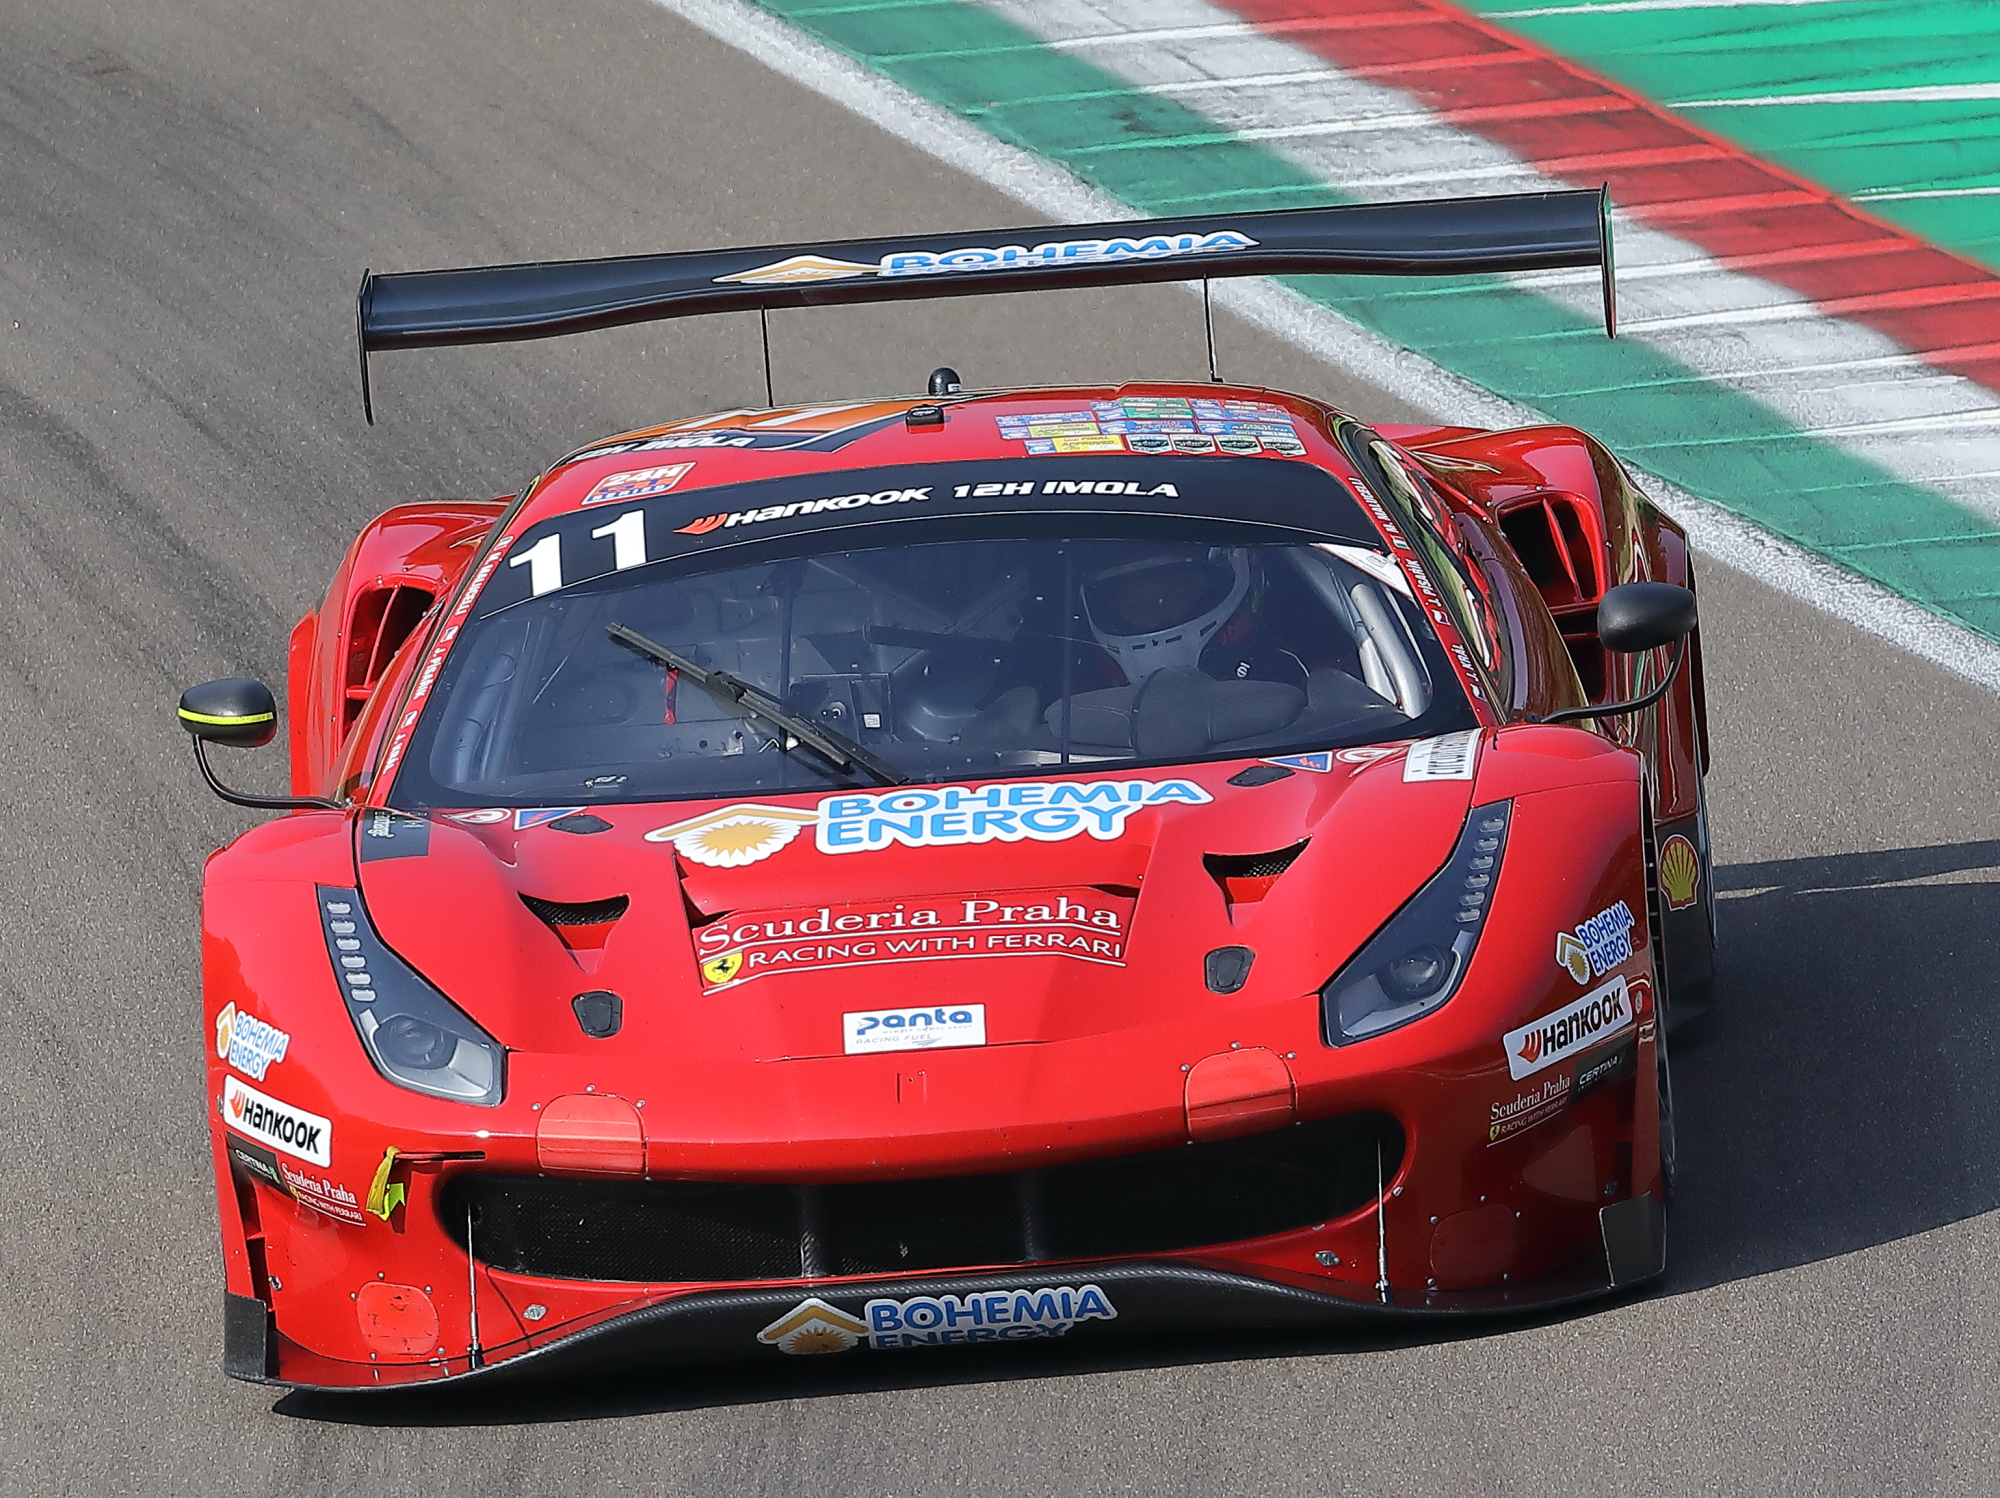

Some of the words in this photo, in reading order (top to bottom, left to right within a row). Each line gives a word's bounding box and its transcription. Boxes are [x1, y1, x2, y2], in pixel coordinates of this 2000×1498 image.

[890, 234, 1246, 269] BOHEMIA
[603, 464, 680, 487] 24H
[952, 482, 1034, 497] 12H
[1042, 481, 1179, 497] IMOLA
[509, 510, 648, 597] 11
[455, 563, 494, 617] MALUCELLI
[829, 782, 1199, 818] BOHEMIA
[827, 804, 1129, 846] ENERGY
[699, 904, 941, 956] Scuderia
[959, 897, 1121, 929] Praha
[1579, 902, 1632, 948] BOHEMIA
[749, 941, 876, 968] RACING
[885, 936, 975, 954] WITH
[987, 933, 1121, 958] FERRARI
[1591, 930, 1630, 973] ENERGY
[235, 1015, 286, 1059] BOHEMIA
[856, 1036, 900, 1045] RACING
[904, 1033, 931, 1041] FUEL
[231, 1040, 270, 1077] ENERGY
[1579, 1055, 1618, 1085] CERTINA
[1490, 1088, 1541, 1120] Scuderia
[1543, 1074, 1571, 1099] Praha
[1501, 1116, 1527, 1134] RACING
[281, 1162, 323, 1194] Scuderia
[322, 1179, 357, 1204] Praha
[871, 1290, 1108, 1330] BOHEMIA
[877, 1323, 1069, 1348] ENERGY
